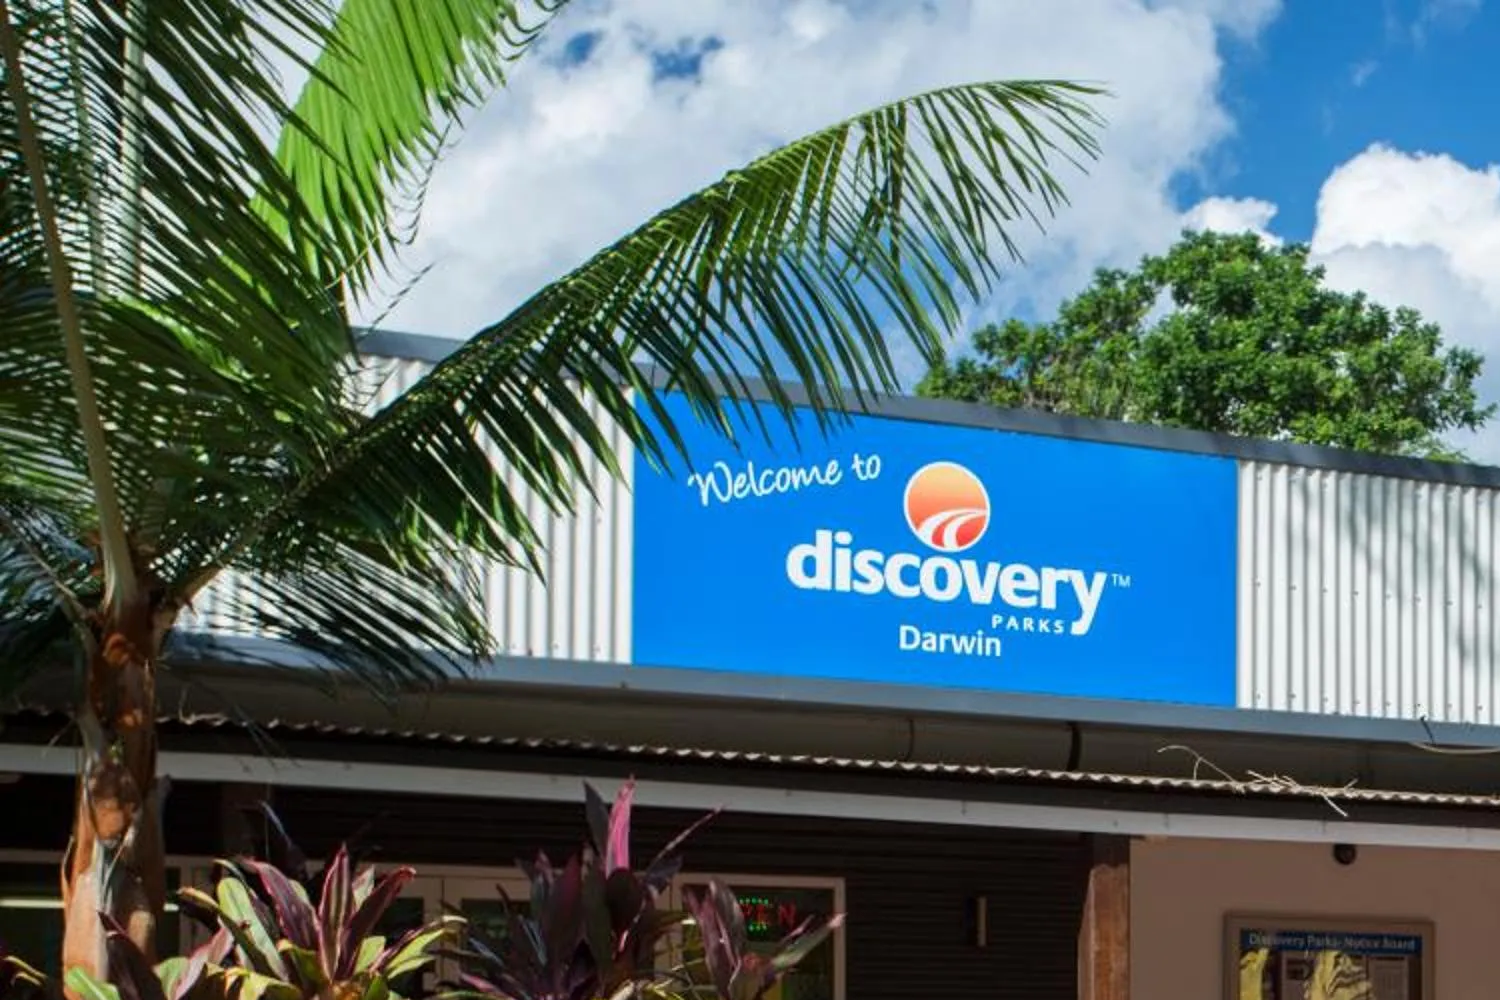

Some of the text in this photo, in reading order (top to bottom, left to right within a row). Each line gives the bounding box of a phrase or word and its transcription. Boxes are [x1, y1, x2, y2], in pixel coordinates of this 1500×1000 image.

[687, 453, 881, 506] Welcome to
[786, 529, 1107, 636] discovery
[899, 624, 1002, 658] Darwin
[991, 614, 1064, 635] PARKS
